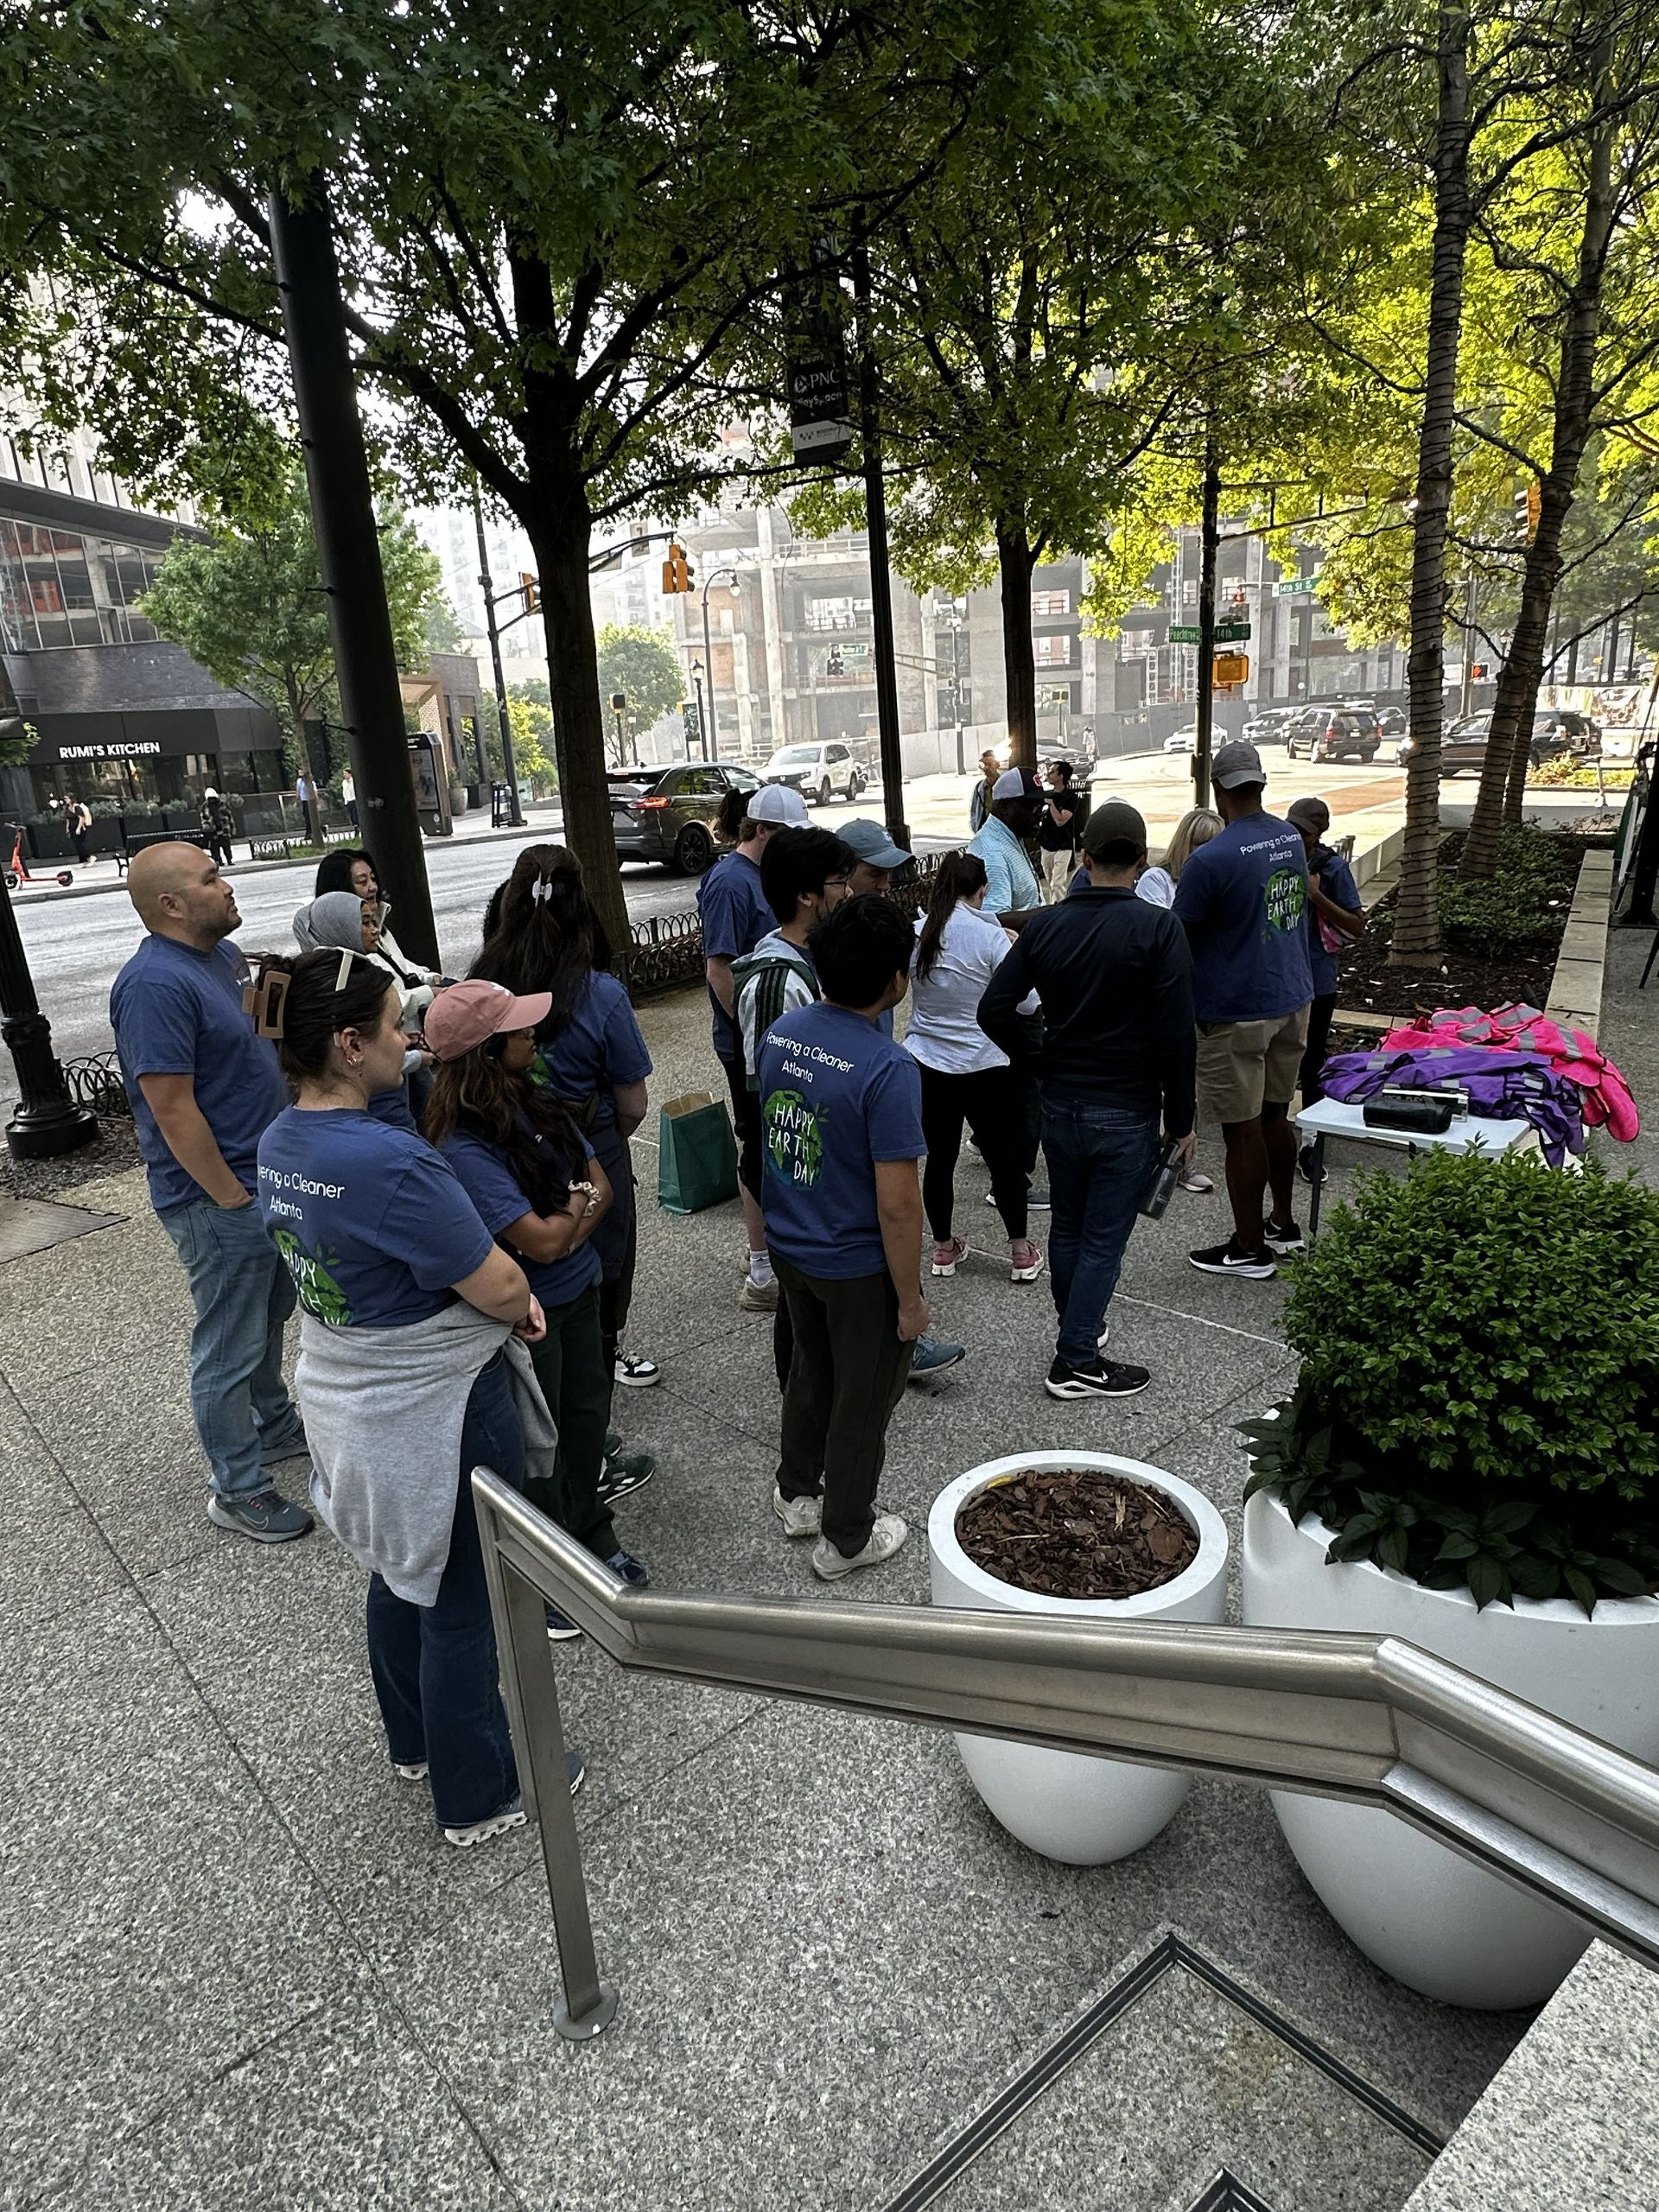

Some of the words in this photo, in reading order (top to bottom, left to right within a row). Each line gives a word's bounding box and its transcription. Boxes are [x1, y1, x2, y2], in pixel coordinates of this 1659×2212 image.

[810, 369, 840, 389] PNC
[59, 745, 105, 759] RUMI'S
[107, 742, 160, 756] KITCHEN
[1239, 838, 1275, 855] Powering
[1268, 849, 1293, 863] Atlanta
[1270, 875, 1300, 901] HAPPY
[1267, 898, 1296, 920] EARTH
[1286, 913, 1300, 931] DAY
[766, 1031, 802, 1057] Powering
[803, 1046, 810, 1058] a
[810, 1046, 855, 1074] Cleaner
[781, 1059, 814, 1084] Atlanta
[774, 1103, 815, 1136] HAPPY
[768, 1127, 810, 1161] EARTH
[258, 1164, 282, 1189] ering
[284, 1174, 290, 1187] a
[292, 1173, 346, 1199] Cleaner
[793, 1160, 816, 1187] DAY
[270, 1195, 303, 1220] Atlanta
